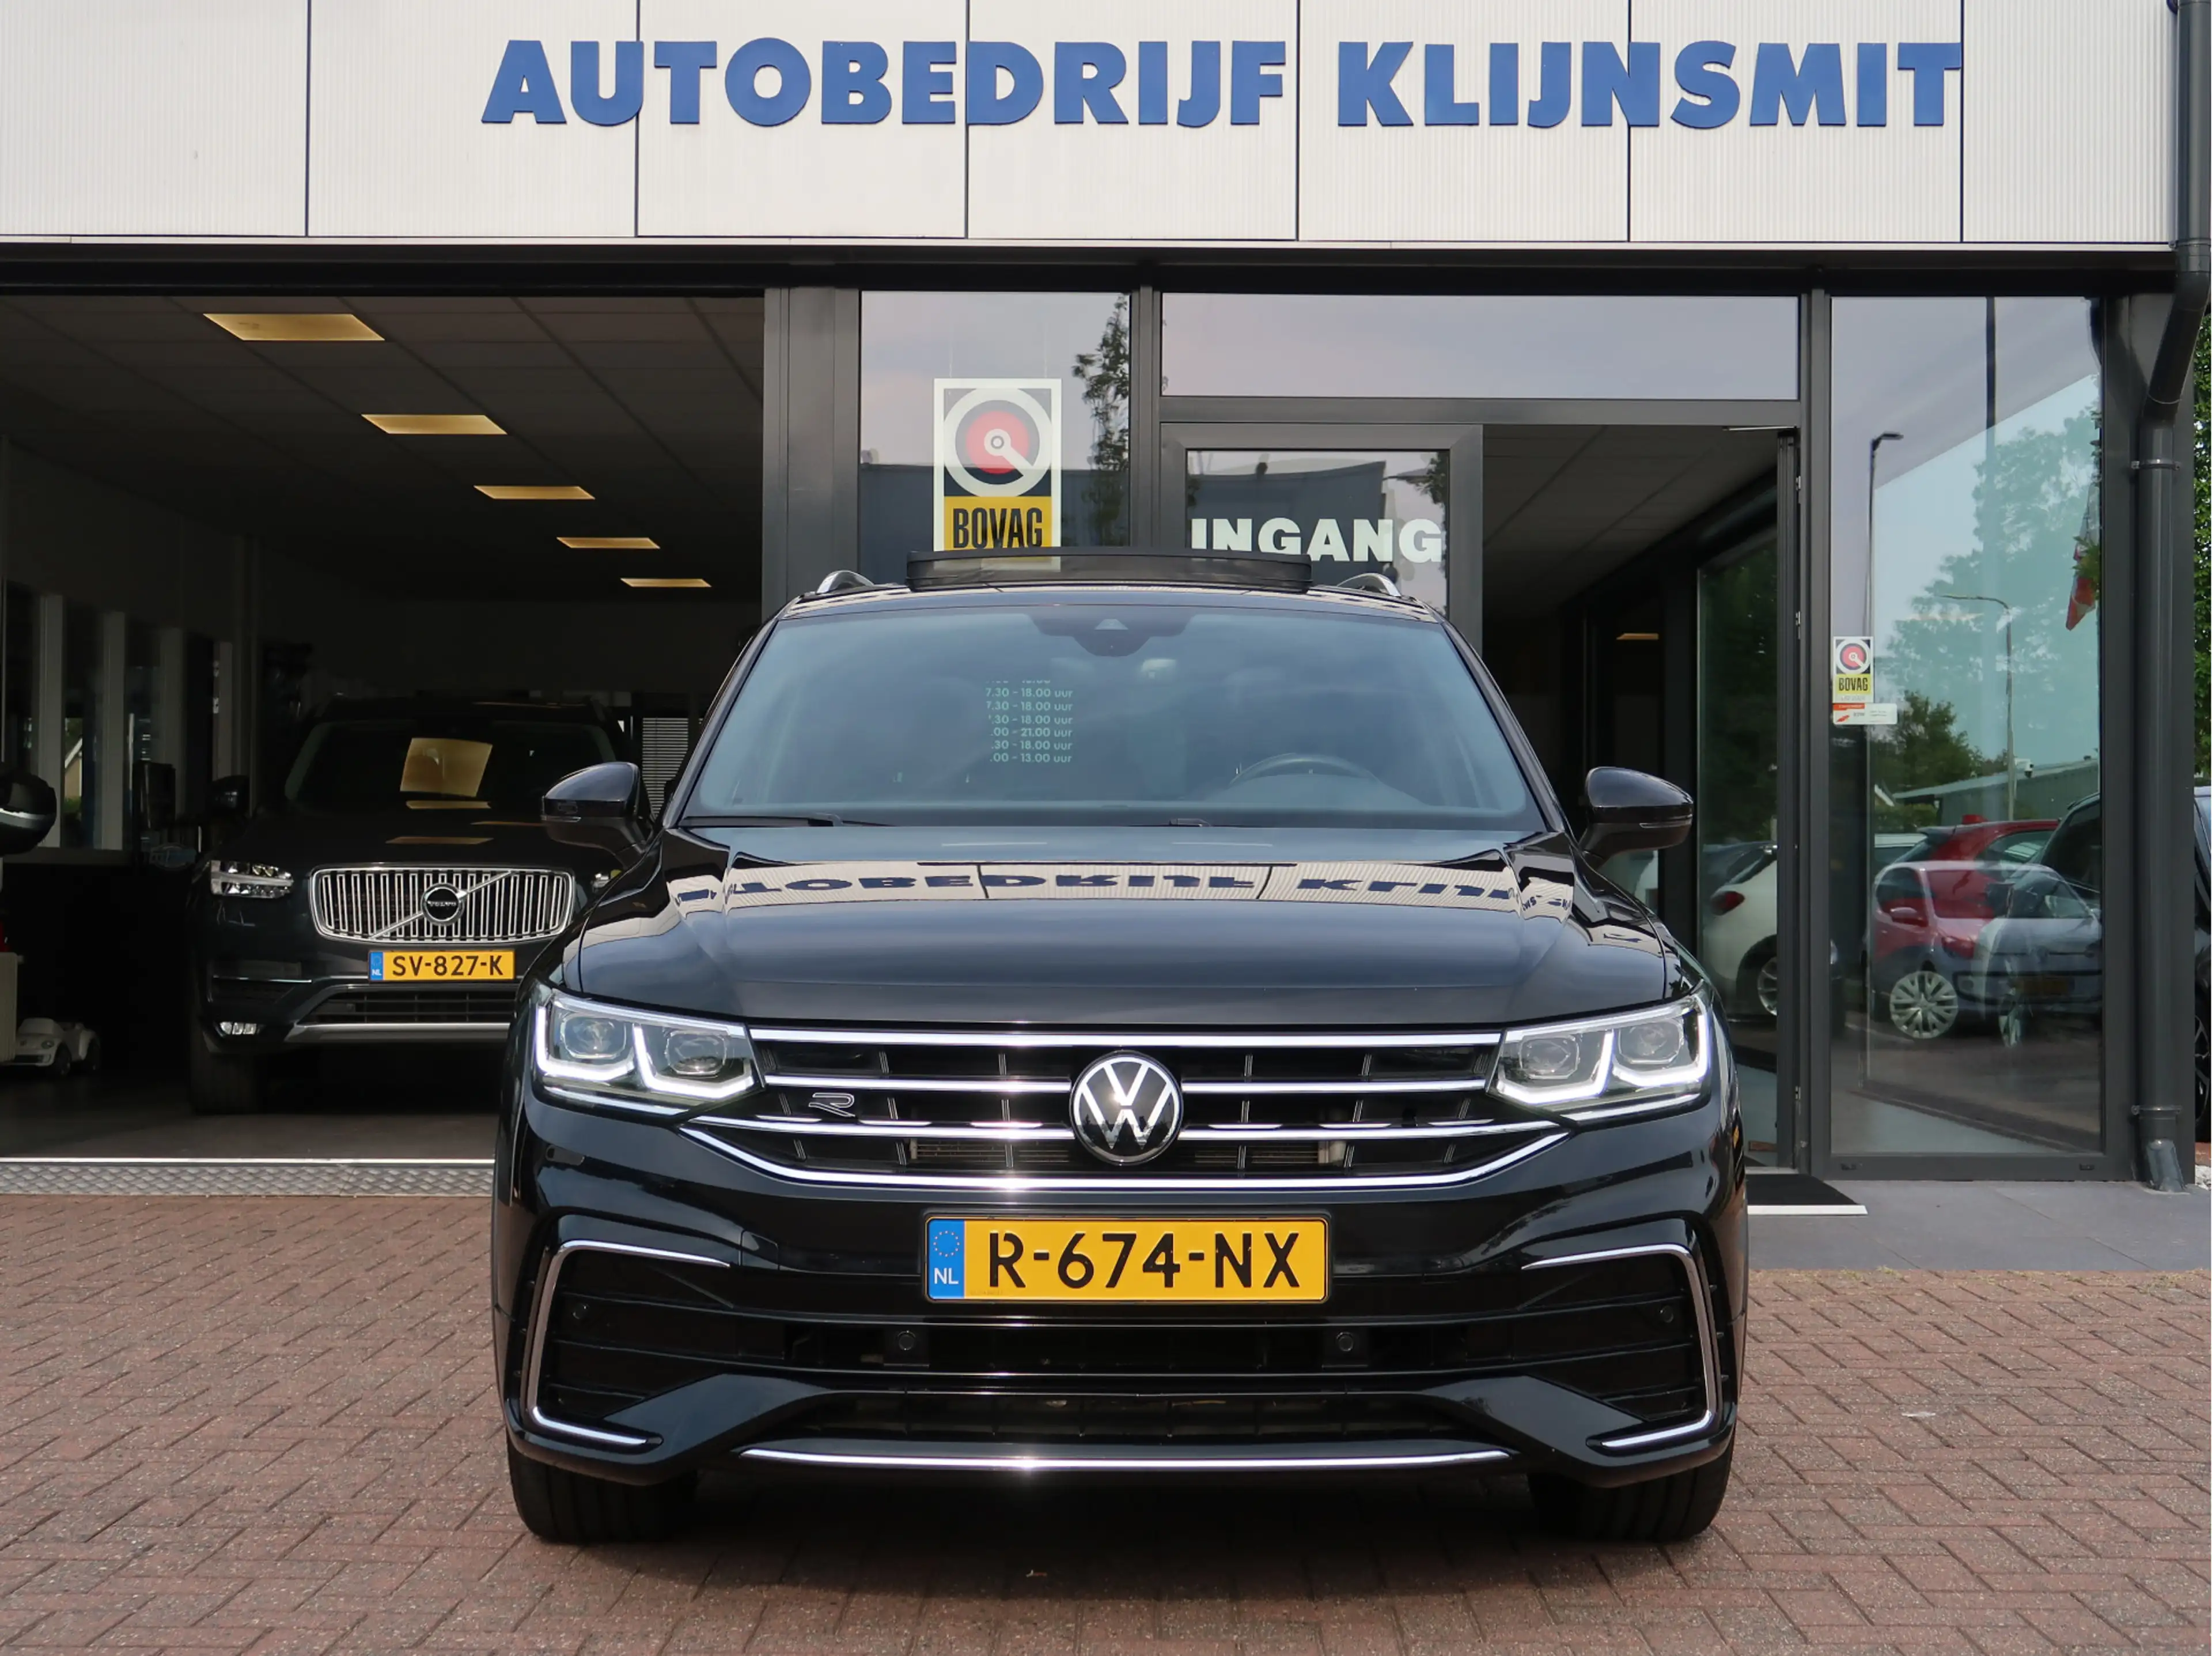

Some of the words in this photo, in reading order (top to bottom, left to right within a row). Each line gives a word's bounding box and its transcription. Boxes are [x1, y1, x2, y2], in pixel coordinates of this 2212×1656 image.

[482, 37, 1285, 127] AUTOBEDRIJF
[1339, 40, 1962, 128] KLIJNSMIT
[953, 508, 1042, 548] BOVAG
[1191, 517, 1441, 563] INGANG
[1839, 677, 1868, 691] BOVAG
[1021, 687, 1051, 697] 18.00
[1021, 701, 1051, 710] 18.00
[988, 715, 1009, 724] .30
[1021, 715, 1051, 724] 18.00
[1020, 727, 1051, 736] 21.00
[1020, 740, 1051, 750] 18.00
[1020, 753, 1050, 762] 13.00
[392, 955, 503, 976] SV-827-K
[934, 1267, 959, 1285] NL
[988, 1231, 1301, 1289] R-674-NX
